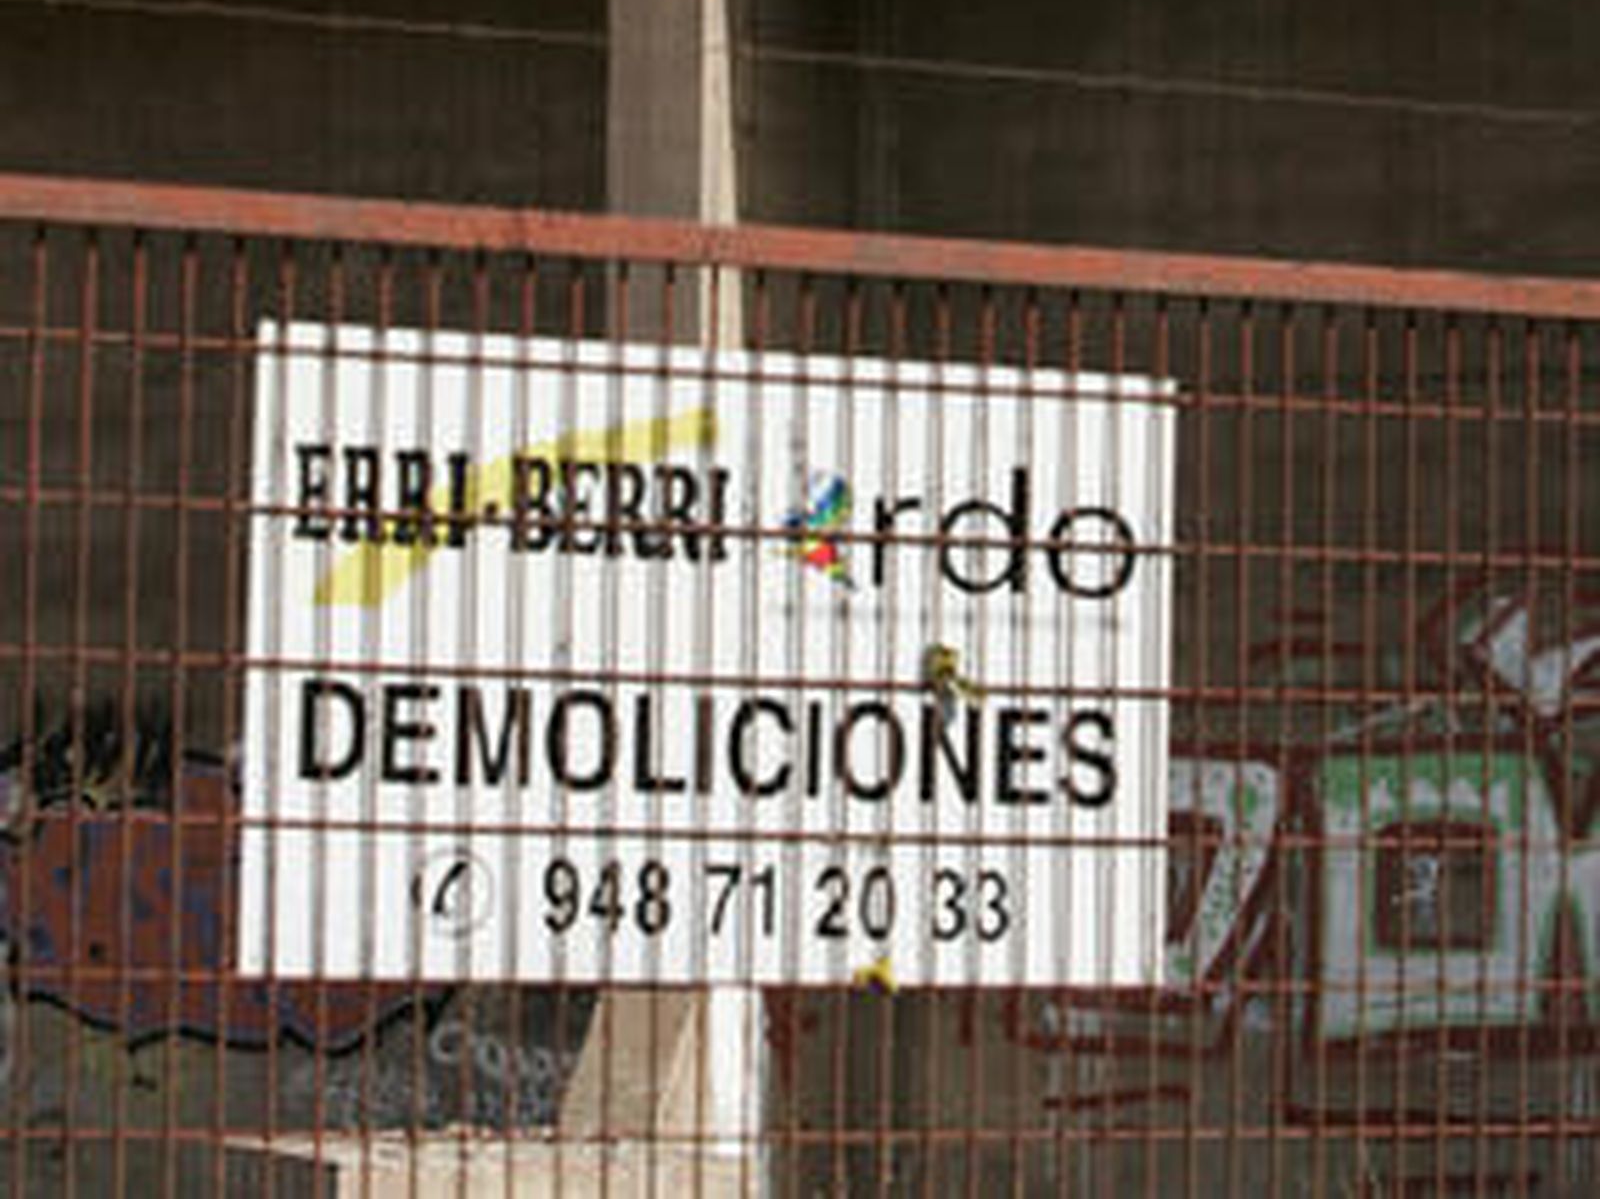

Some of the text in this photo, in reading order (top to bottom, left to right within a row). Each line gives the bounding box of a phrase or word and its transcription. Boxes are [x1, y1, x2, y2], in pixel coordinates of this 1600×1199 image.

[873, 466, 1136, 599] rdo
[297, 678, 1118, 808] DEMOLICIONES
[542, 857, 1011, 943] 948 71 20 33
